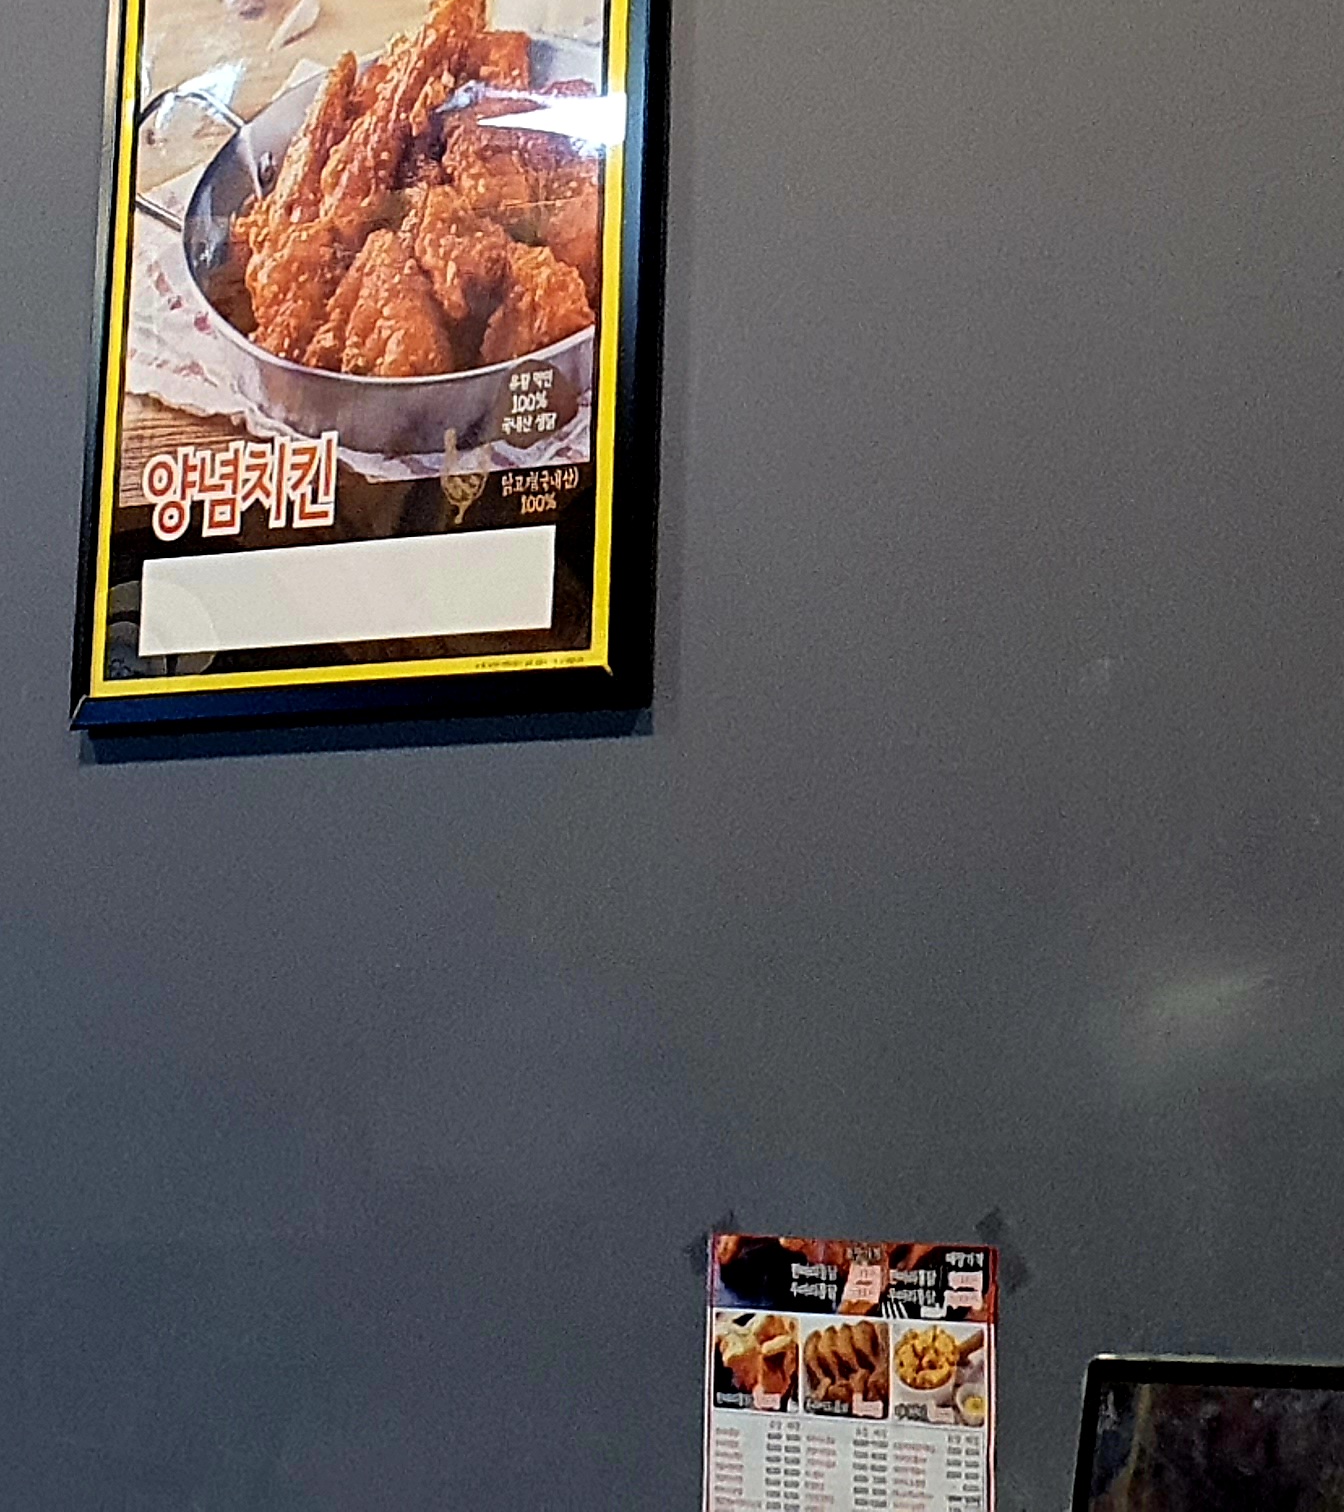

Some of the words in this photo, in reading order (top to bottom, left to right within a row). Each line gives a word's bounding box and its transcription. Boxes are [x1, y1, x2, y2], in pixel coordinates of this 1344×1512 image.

[512, 391, 548, 414] 100%
[501, 414, 533, 435] 국내산
[143, 431, 338, 541] 양념치킨
[521, 493, 556, 515] 100%
